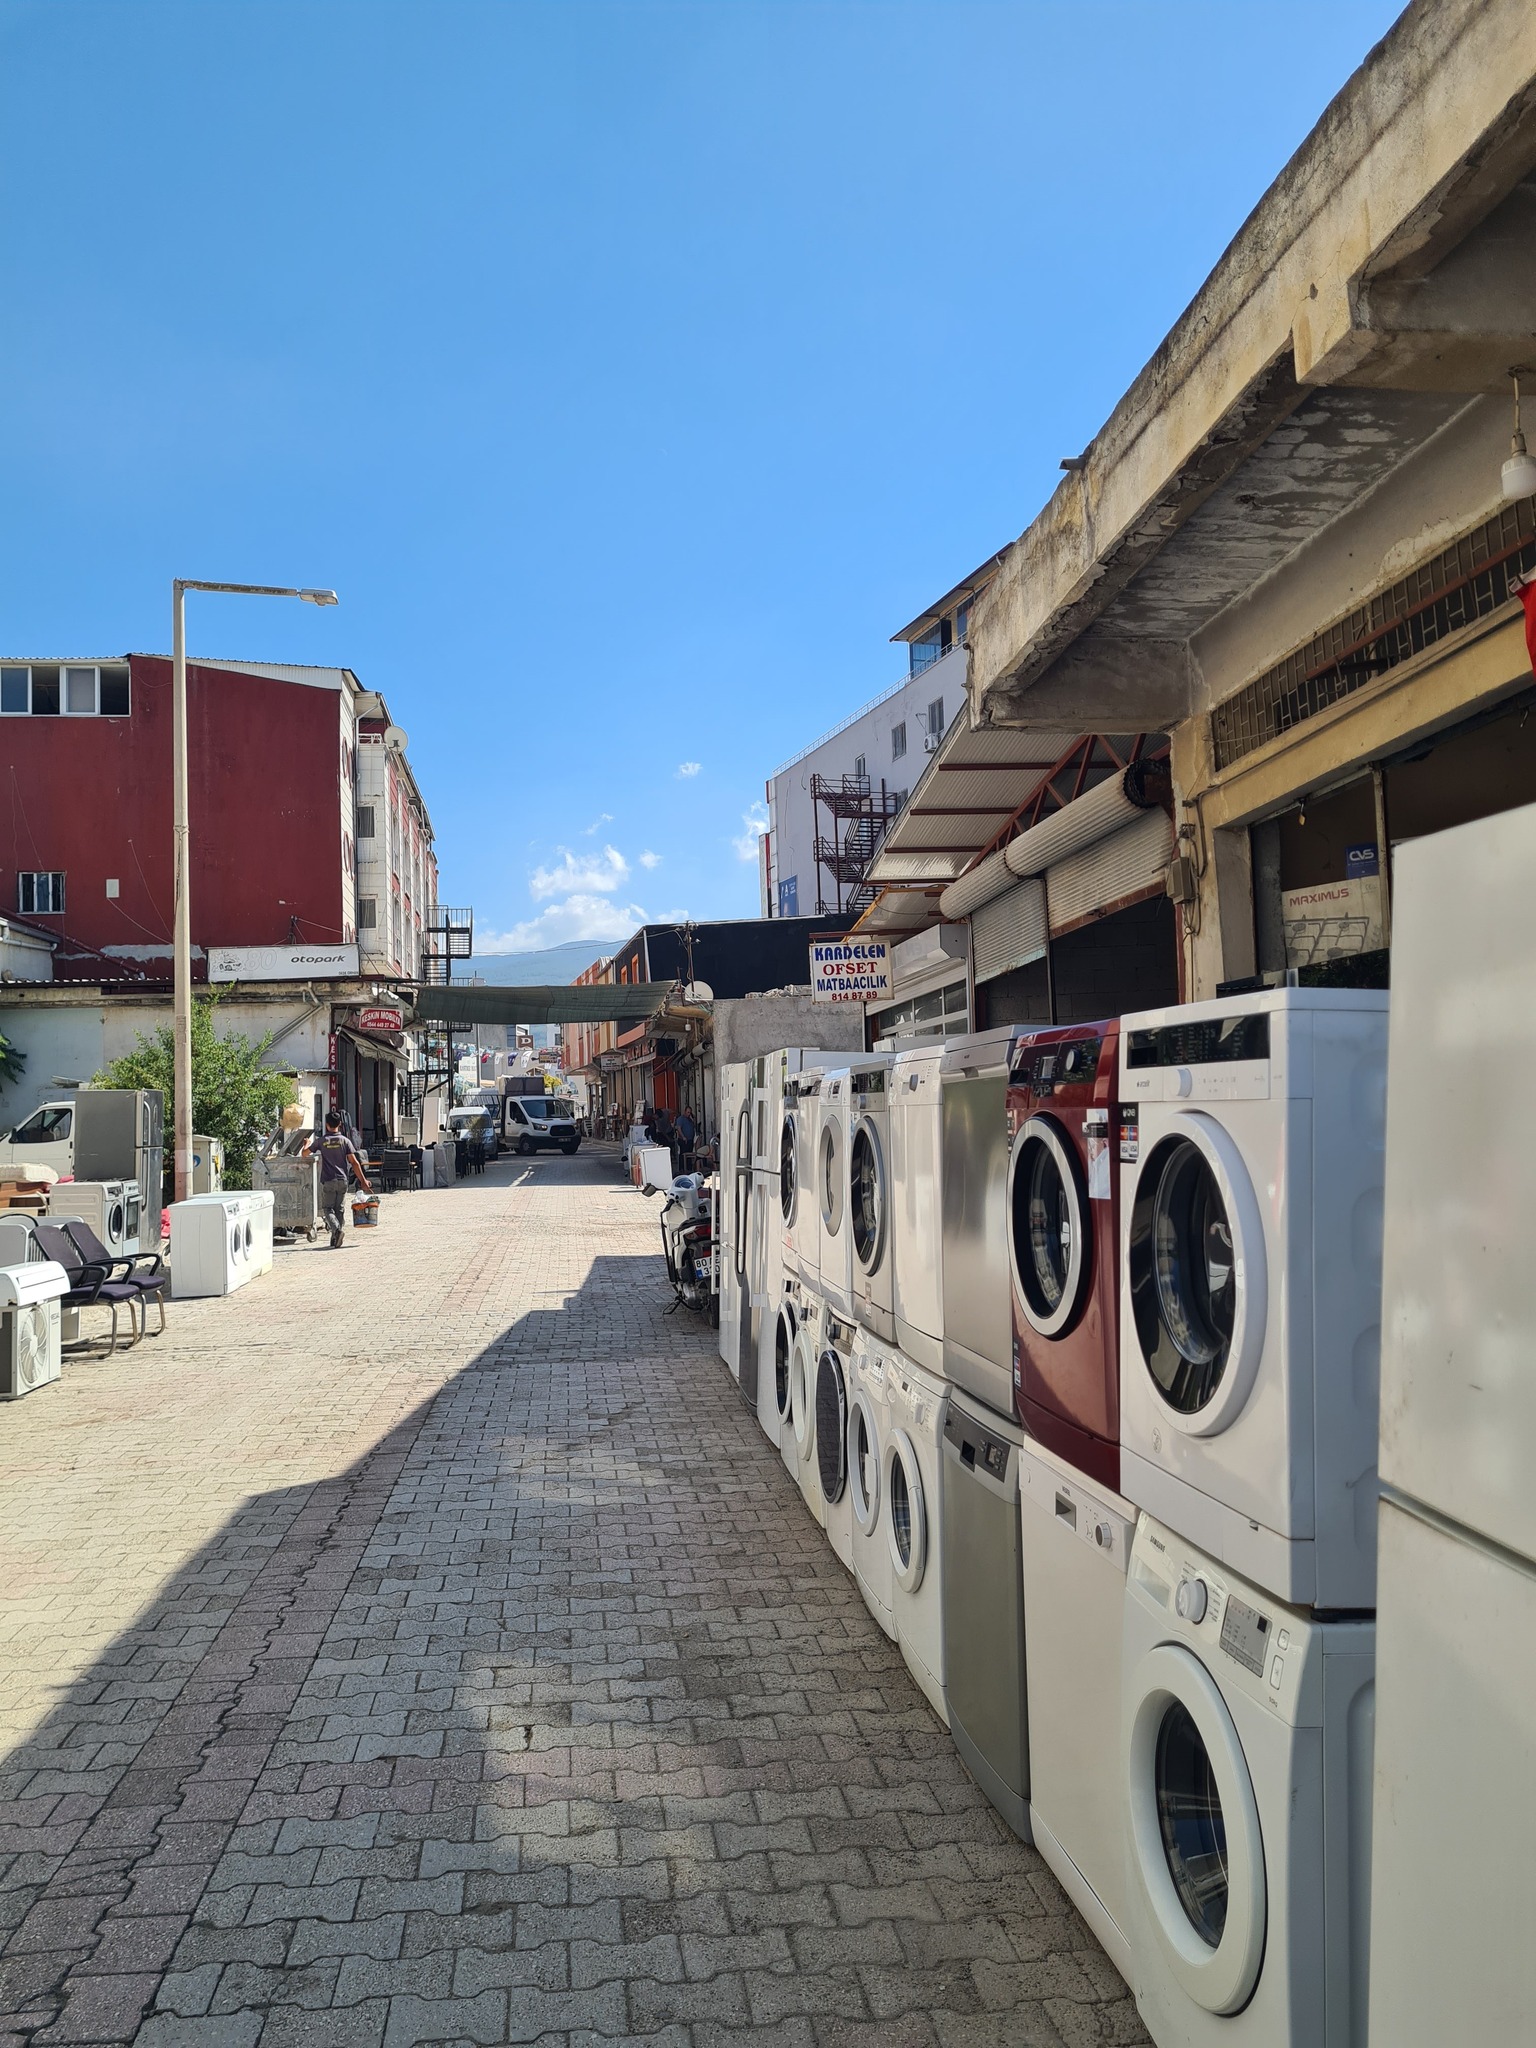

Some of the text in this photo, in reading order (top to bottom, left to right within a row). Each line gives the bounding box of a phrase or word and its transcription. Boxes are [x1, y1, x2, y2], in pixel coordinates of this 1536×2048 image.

[1349, 849, 1374, 861] CVS
[1289, 888, 1349, 908] MAXIMUS
[245, 949, 346, 971] 80 otopark
[815, 945, 886, 961] KARDELEN
[823, 962, 877, 976] OFSET
[817, 975, 887, 991] MATBAACILIK
[832, 993, 848, 1001] 814
[866, 991, 877, 999] 89
[695, 1258, 708, 1268] 80
[1150, 1535, 1166, 1553] SAMSUNG
